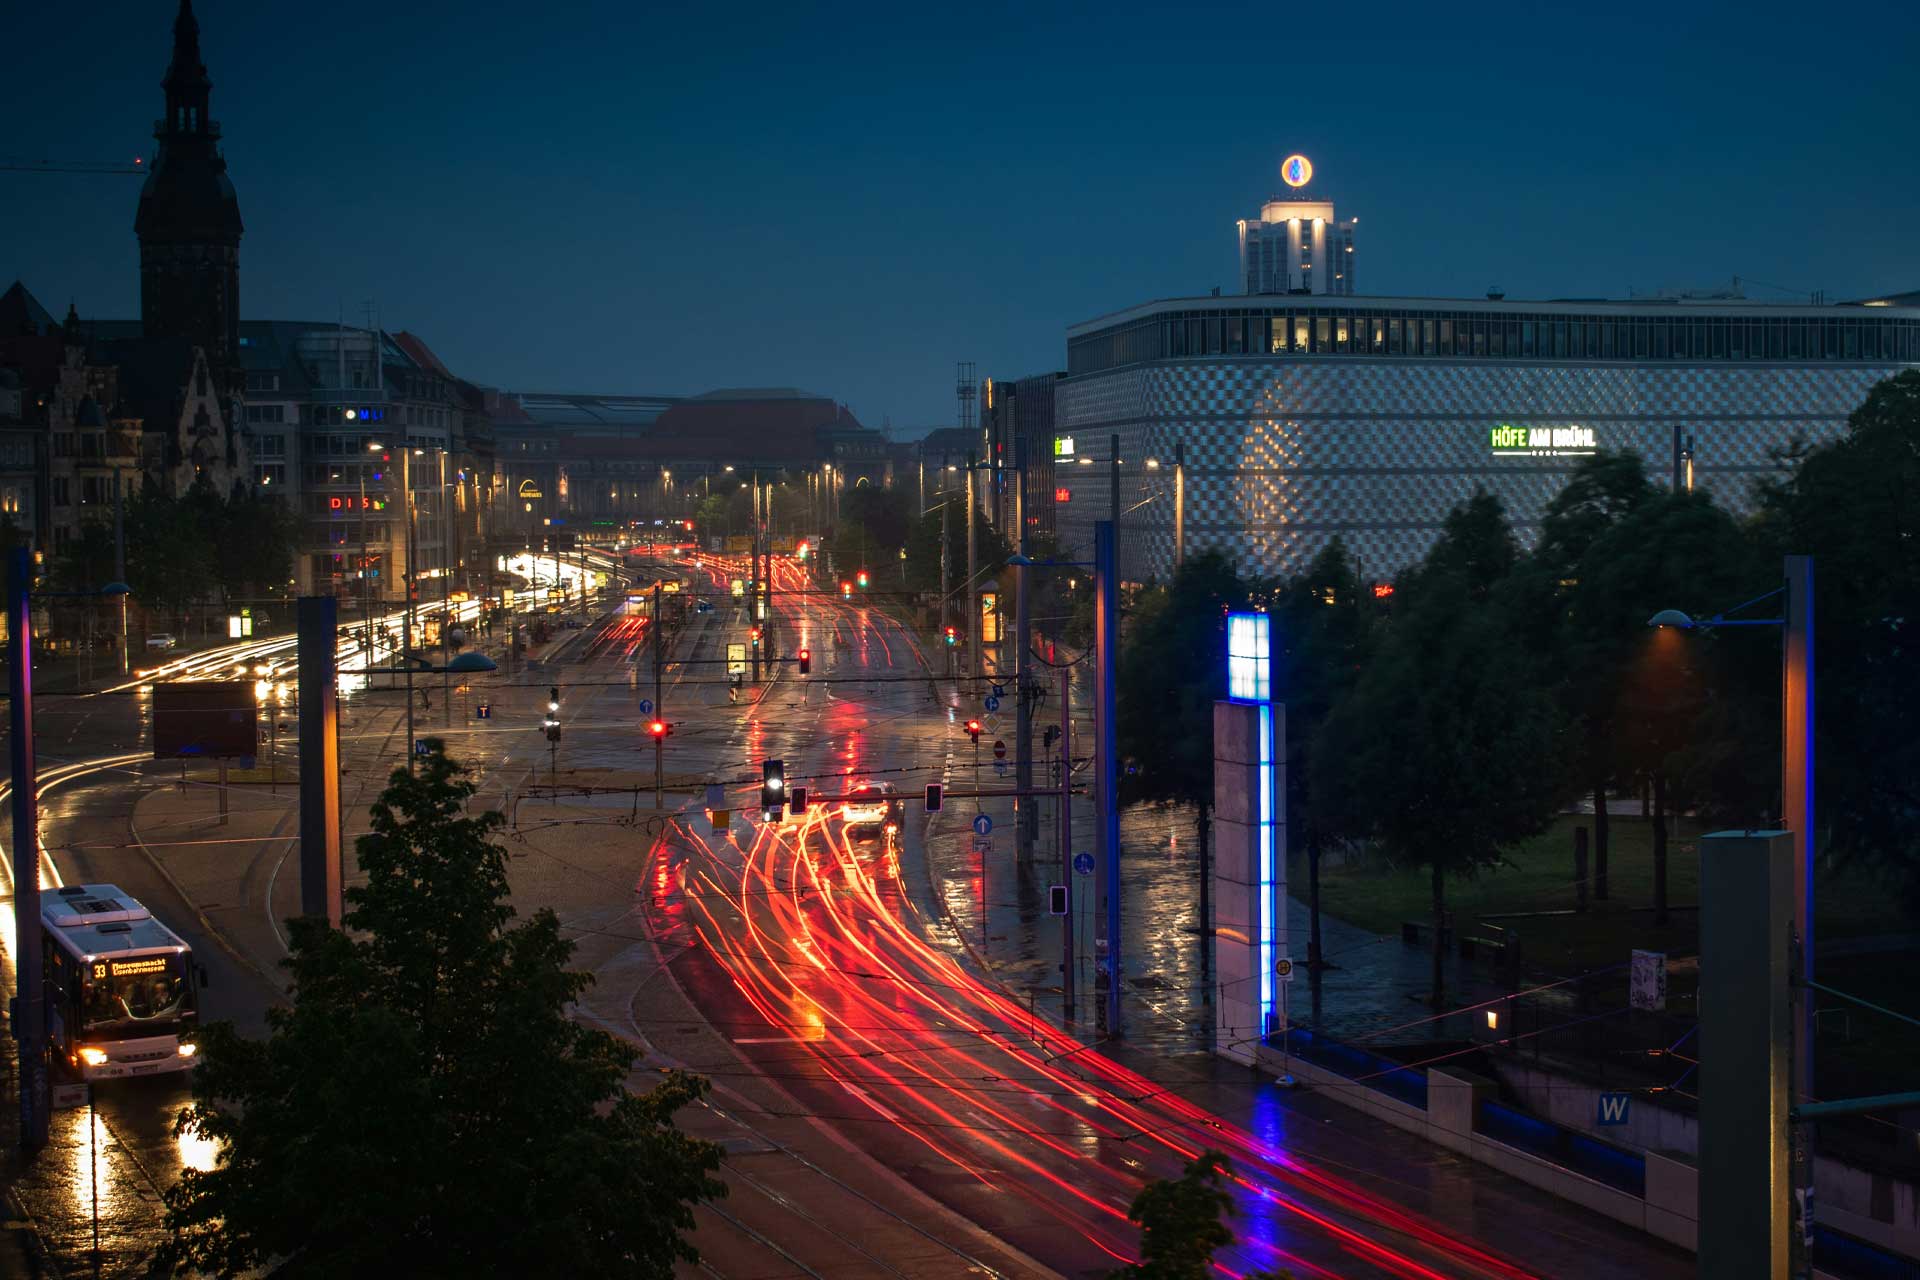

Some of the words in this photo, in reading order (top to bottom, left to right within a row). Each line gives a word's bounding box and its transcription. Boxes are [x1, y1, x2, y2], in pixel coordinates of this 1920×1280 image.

[1492, 425, 1526, 447] HÖFE
[1529, 428, 1551, 447] AM
[1553, 425, 1597, 447] BRÜHL
[94, 964, 106, 979] 33
[1602, 1096, 1628, 1121] W
